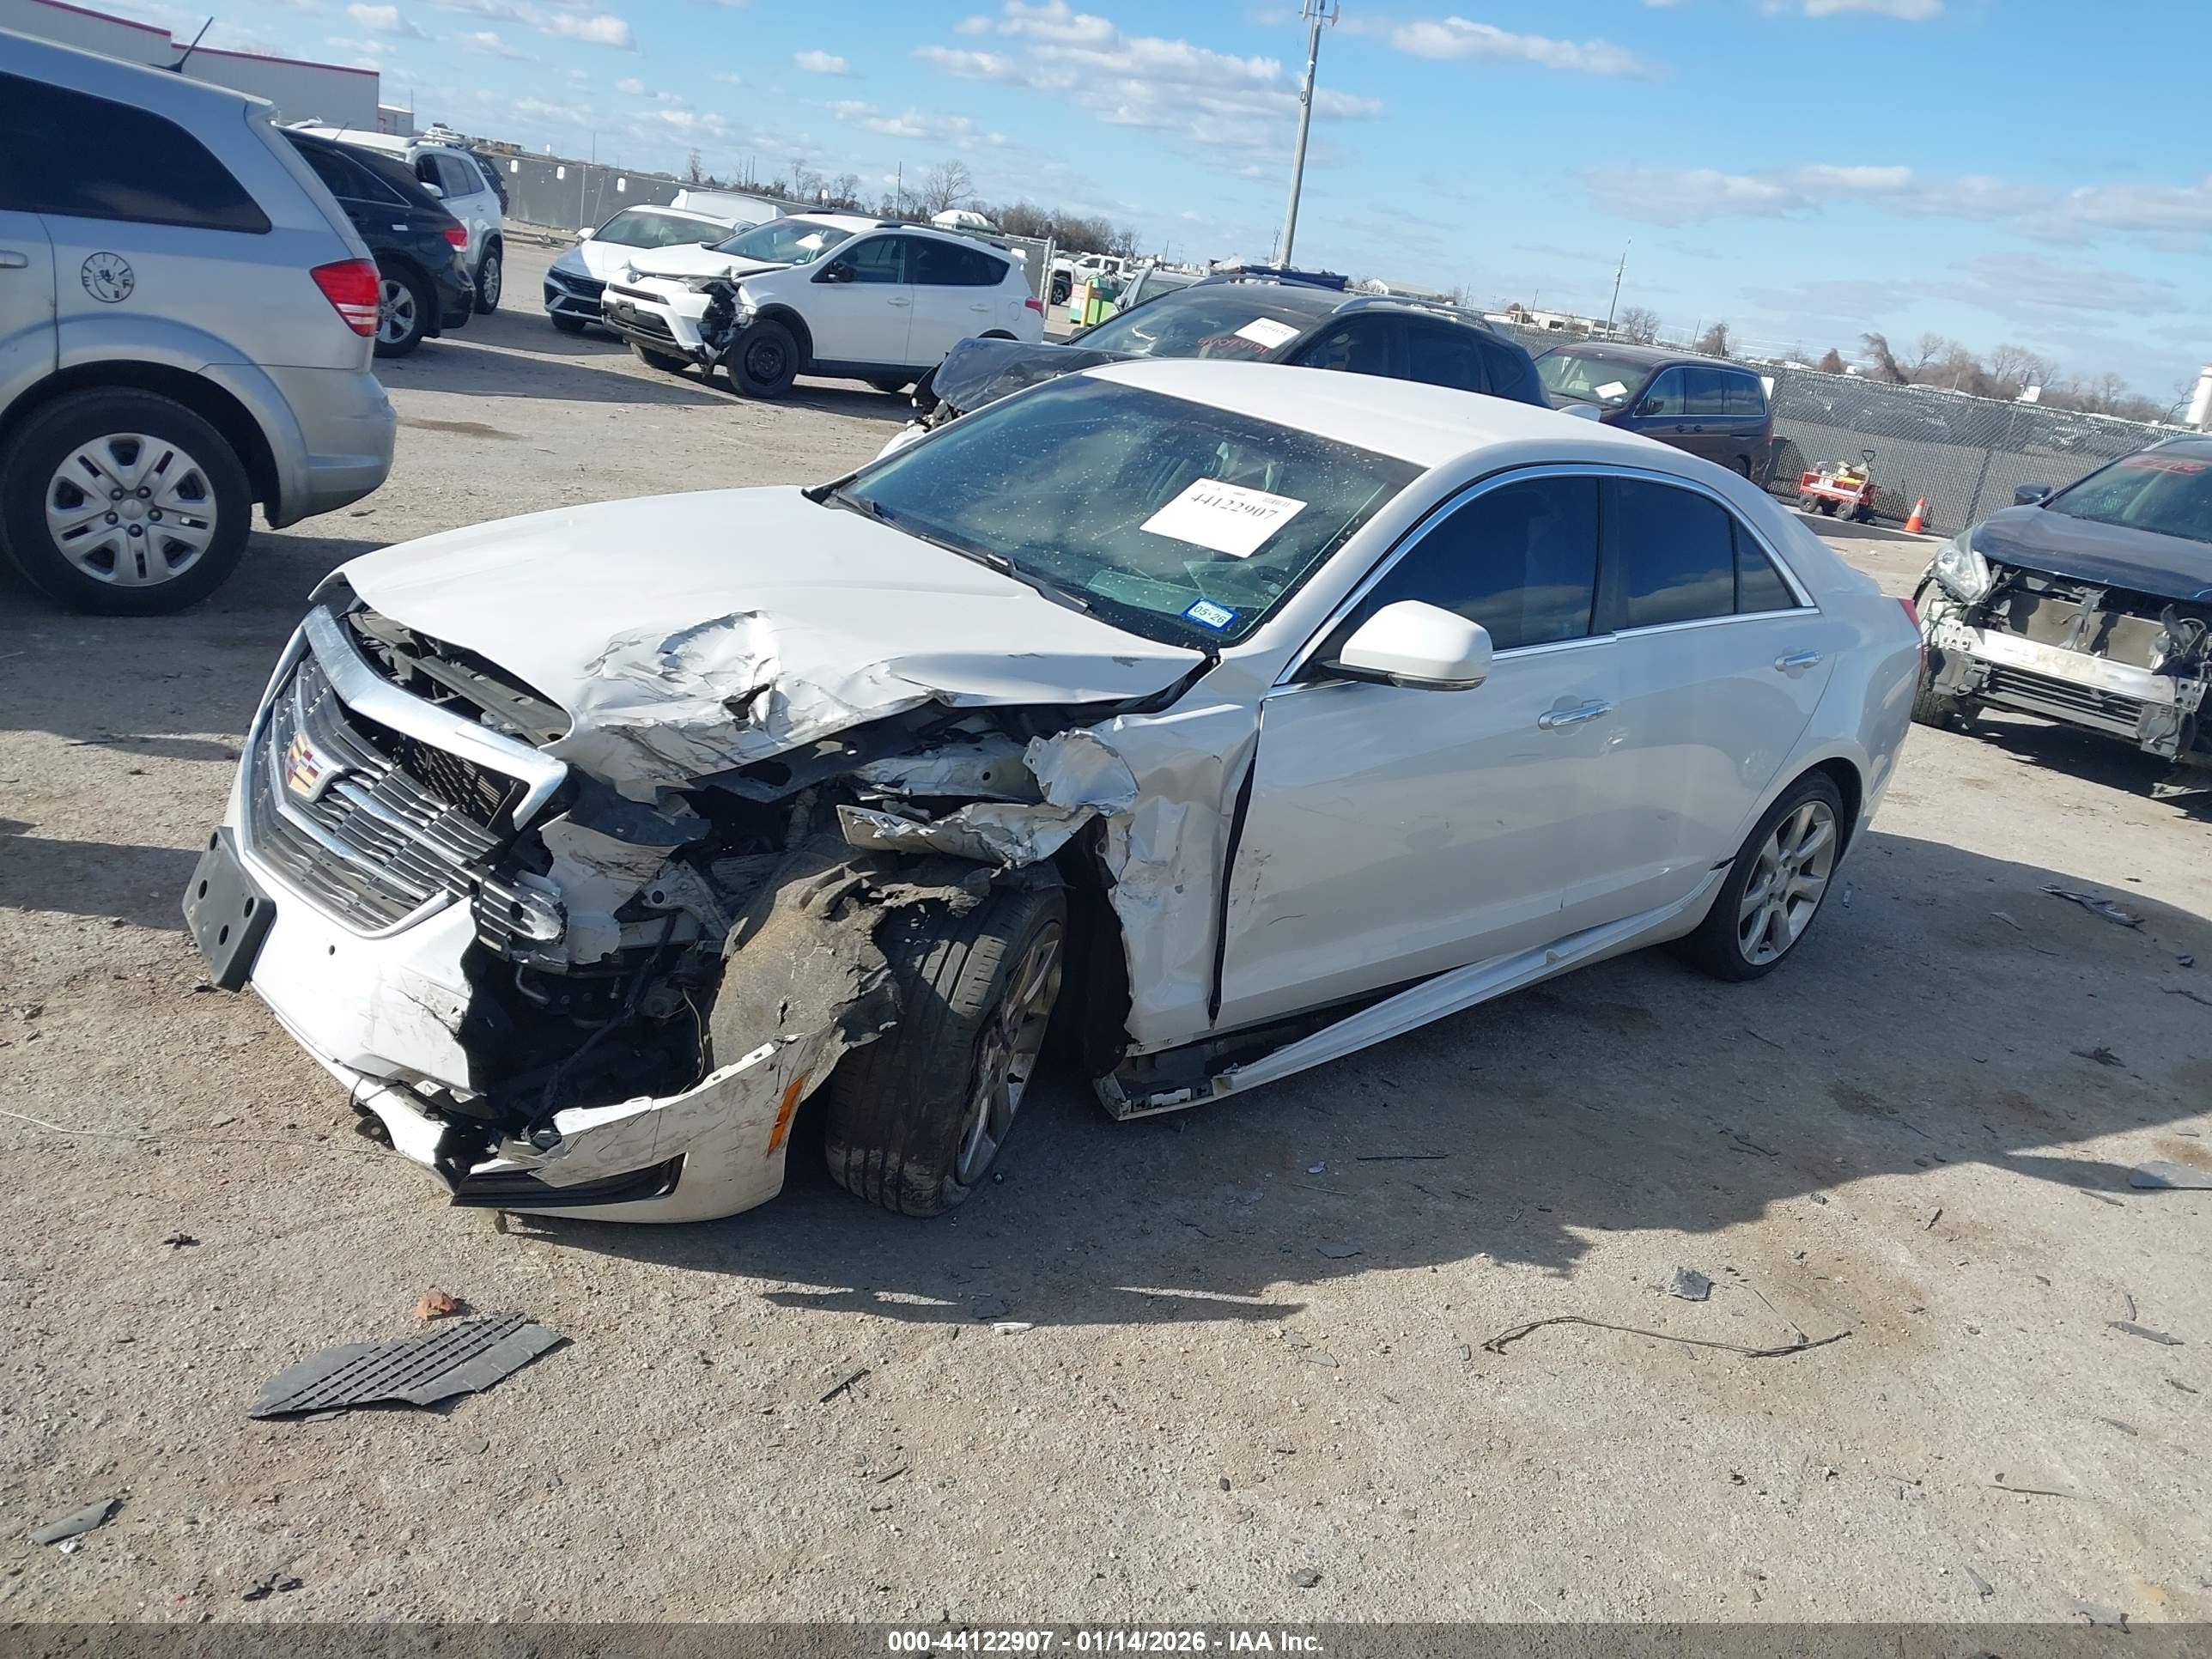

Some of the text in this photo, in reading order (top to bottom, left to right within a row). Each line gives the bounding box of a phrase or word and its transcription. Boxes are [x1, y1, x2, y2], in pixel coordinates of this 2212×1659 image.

[82, 276, 90, 287] E
[122, 279, 131, 289] F
[1190, 493, 1279, 520] 44122907
